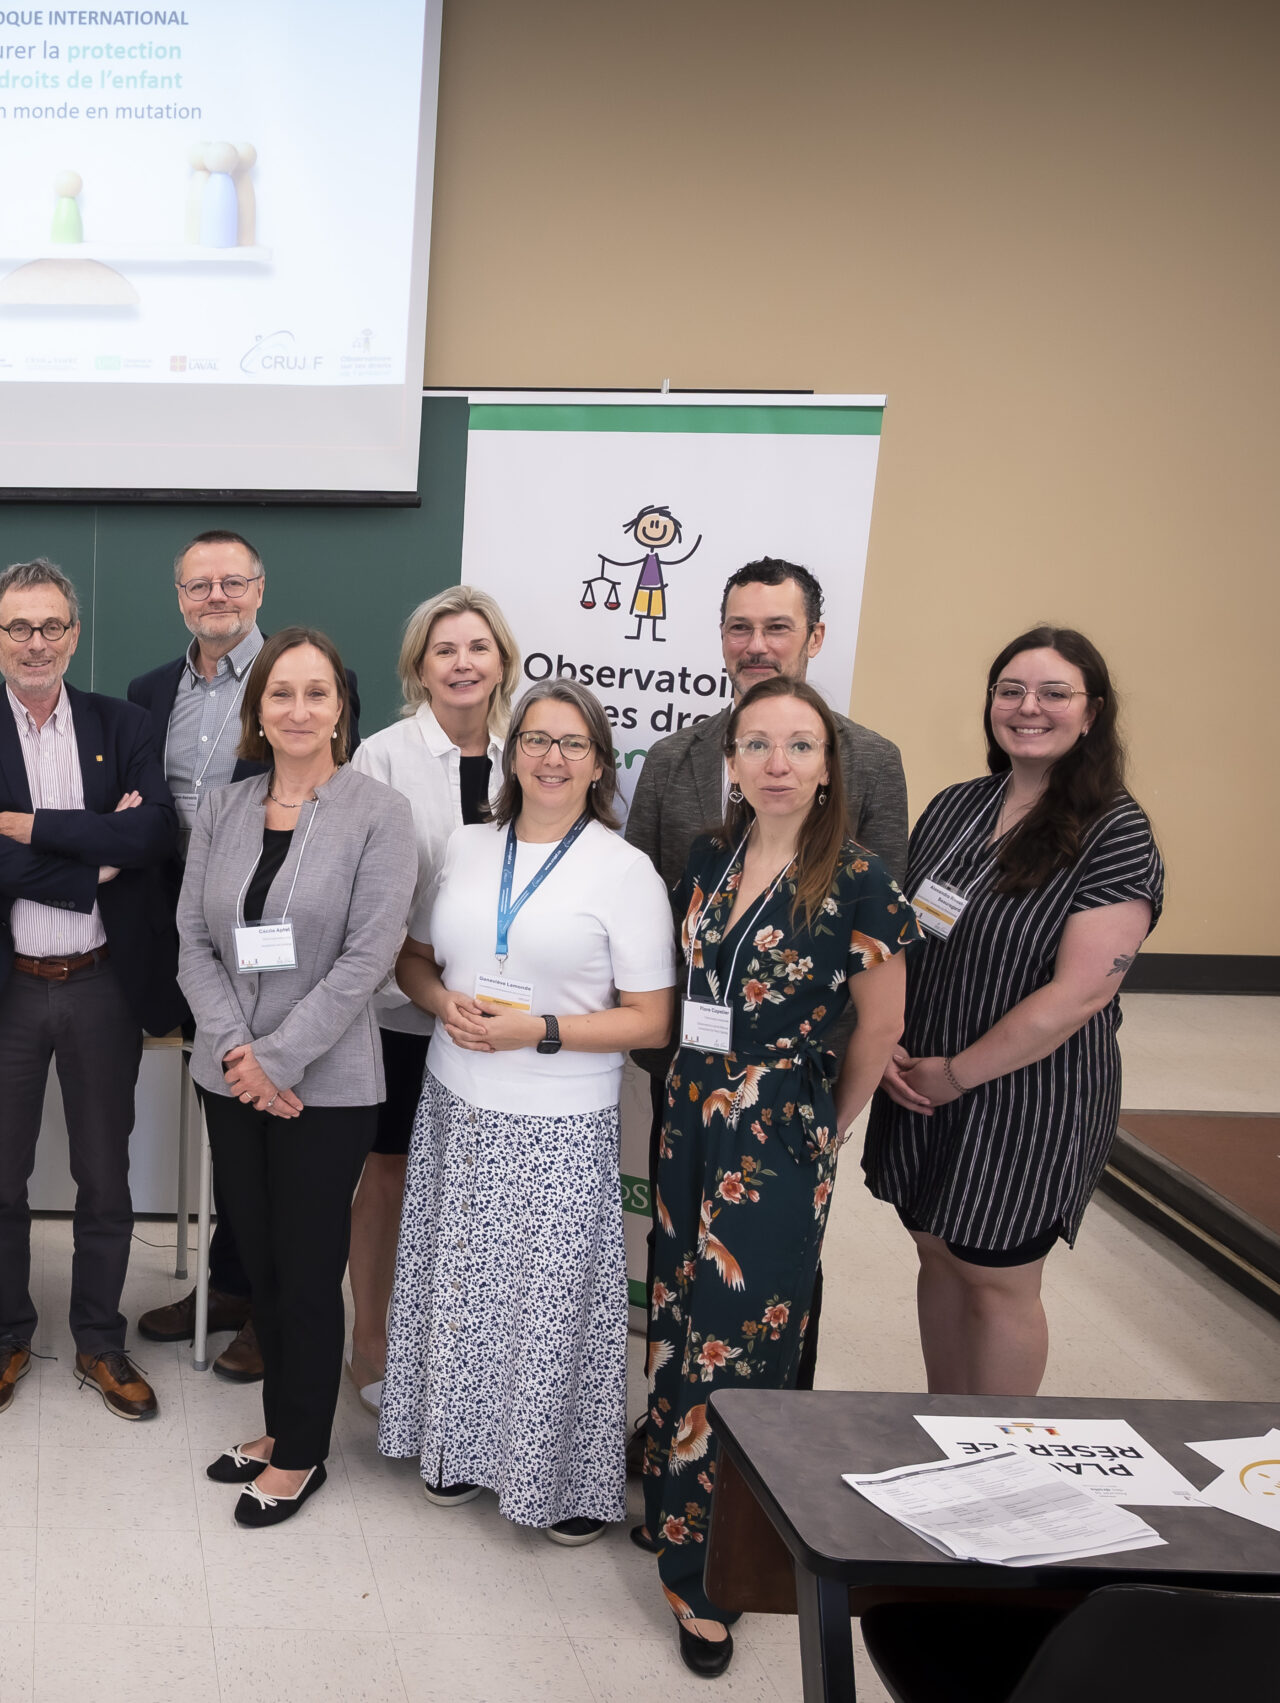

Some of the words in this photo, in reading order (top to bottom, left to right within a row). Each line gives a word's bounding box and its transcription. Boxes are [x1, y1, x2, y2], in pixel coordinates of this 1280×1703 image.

[48, 10, 190, 26] INTERNATIONAL
[42, 39, 61, 60] la
[67, 40, 183, 63] protection
[66, 70, 94, 90] de
[13, 102, 80, 120] monde
[85, 105, 109, 120] en
[115, 102, 203, 120] mutation
[261, 354, 325, 371] CRUJF
[523, 652, 735, 699] Observatoi
[604, 704, 638, 730] es
